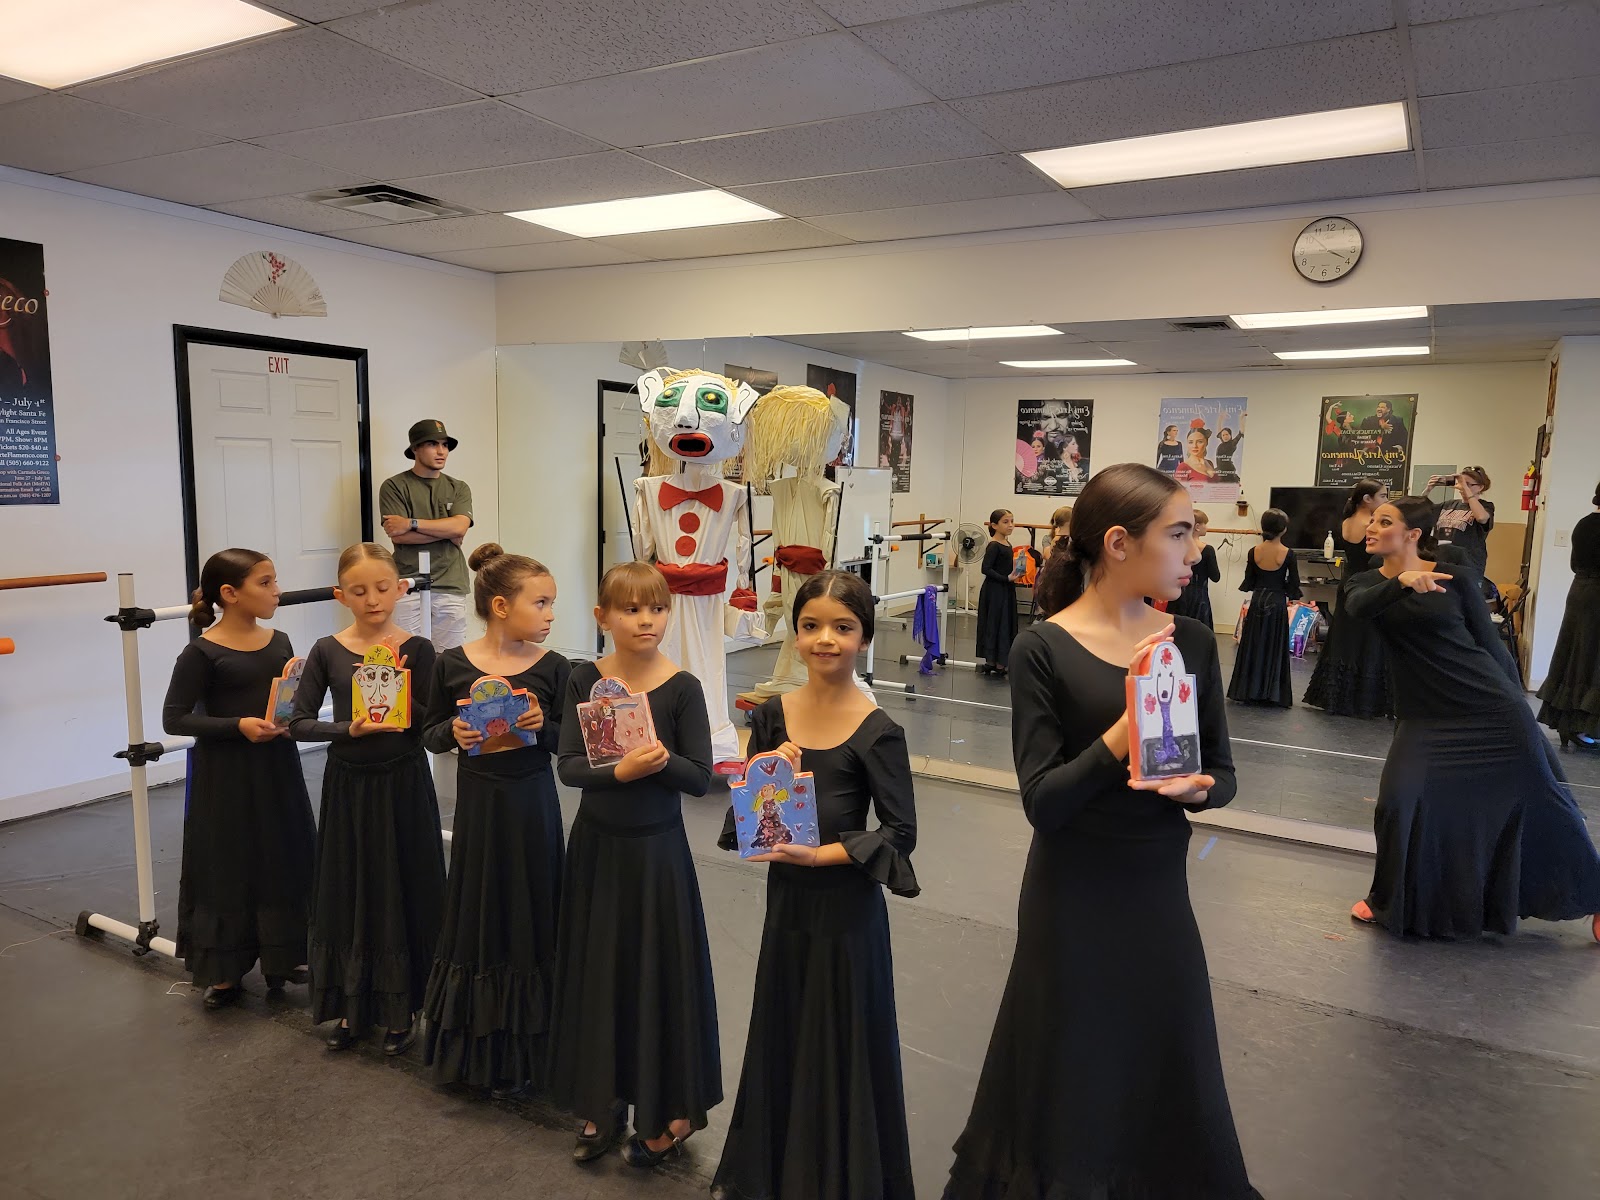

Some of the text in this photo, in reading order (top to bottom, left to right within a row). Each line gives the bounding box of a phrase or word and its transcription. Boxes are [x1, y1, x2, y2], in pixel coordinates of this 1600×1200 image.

[1326, 223, 1336, 232] 12
[1302, 258, 1307, 266] 8
[0, 295, 38, 314] eco
[268, 356, 289, 374] EXIT
[12, 397, 32, 410] July
